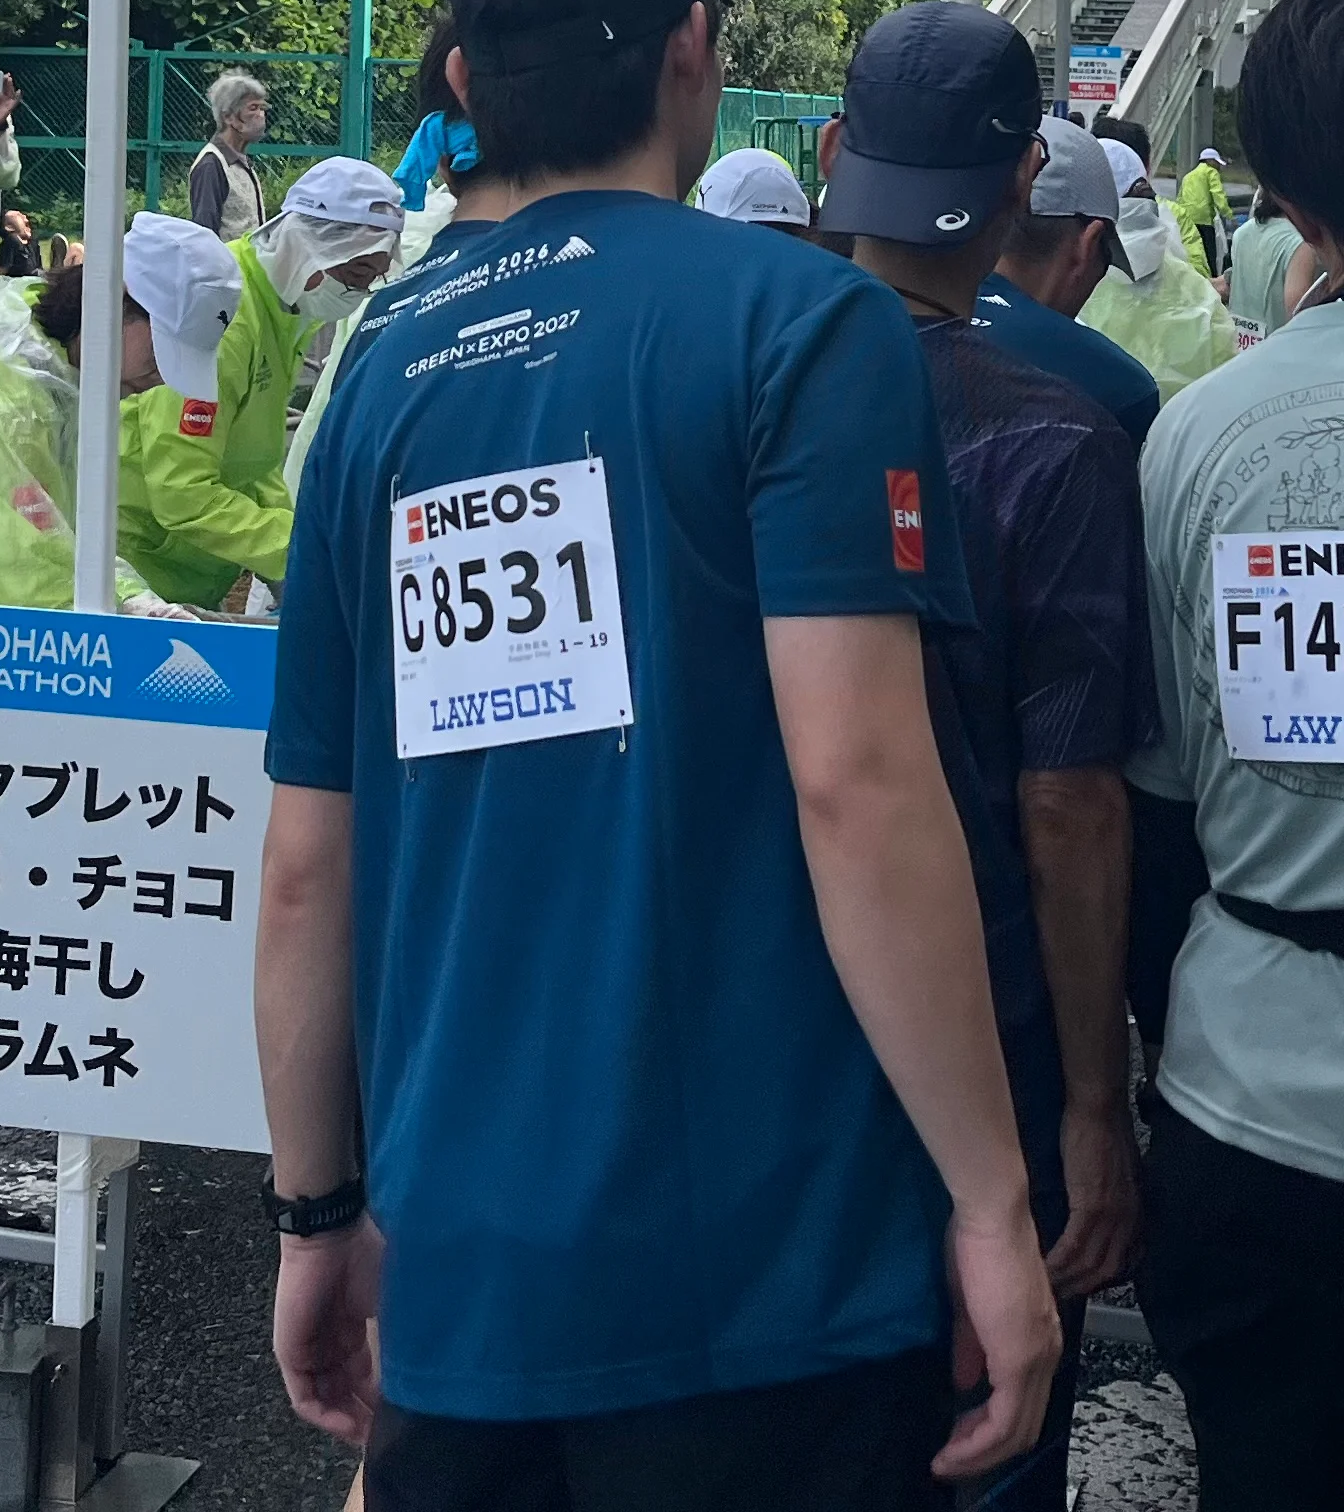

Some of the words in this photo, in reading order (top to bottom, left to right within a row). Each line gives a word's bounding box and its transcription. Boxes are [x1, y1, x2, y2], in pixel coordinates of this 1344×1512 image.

[415, 276, 489, 318] MARATHON
[419, 263, 490, 306] YOKOHAMA
[497, 243, 549, 272] 2026
[533, 309, 581, 339] 2027
[970, 317, 992, 326] 27
[424, 477, 561, 540] ENEOS
[894, 509, 923, 529] EN
[400, 540, 593, 653] C8531
[430, 678, 576, 732] LAWSON
